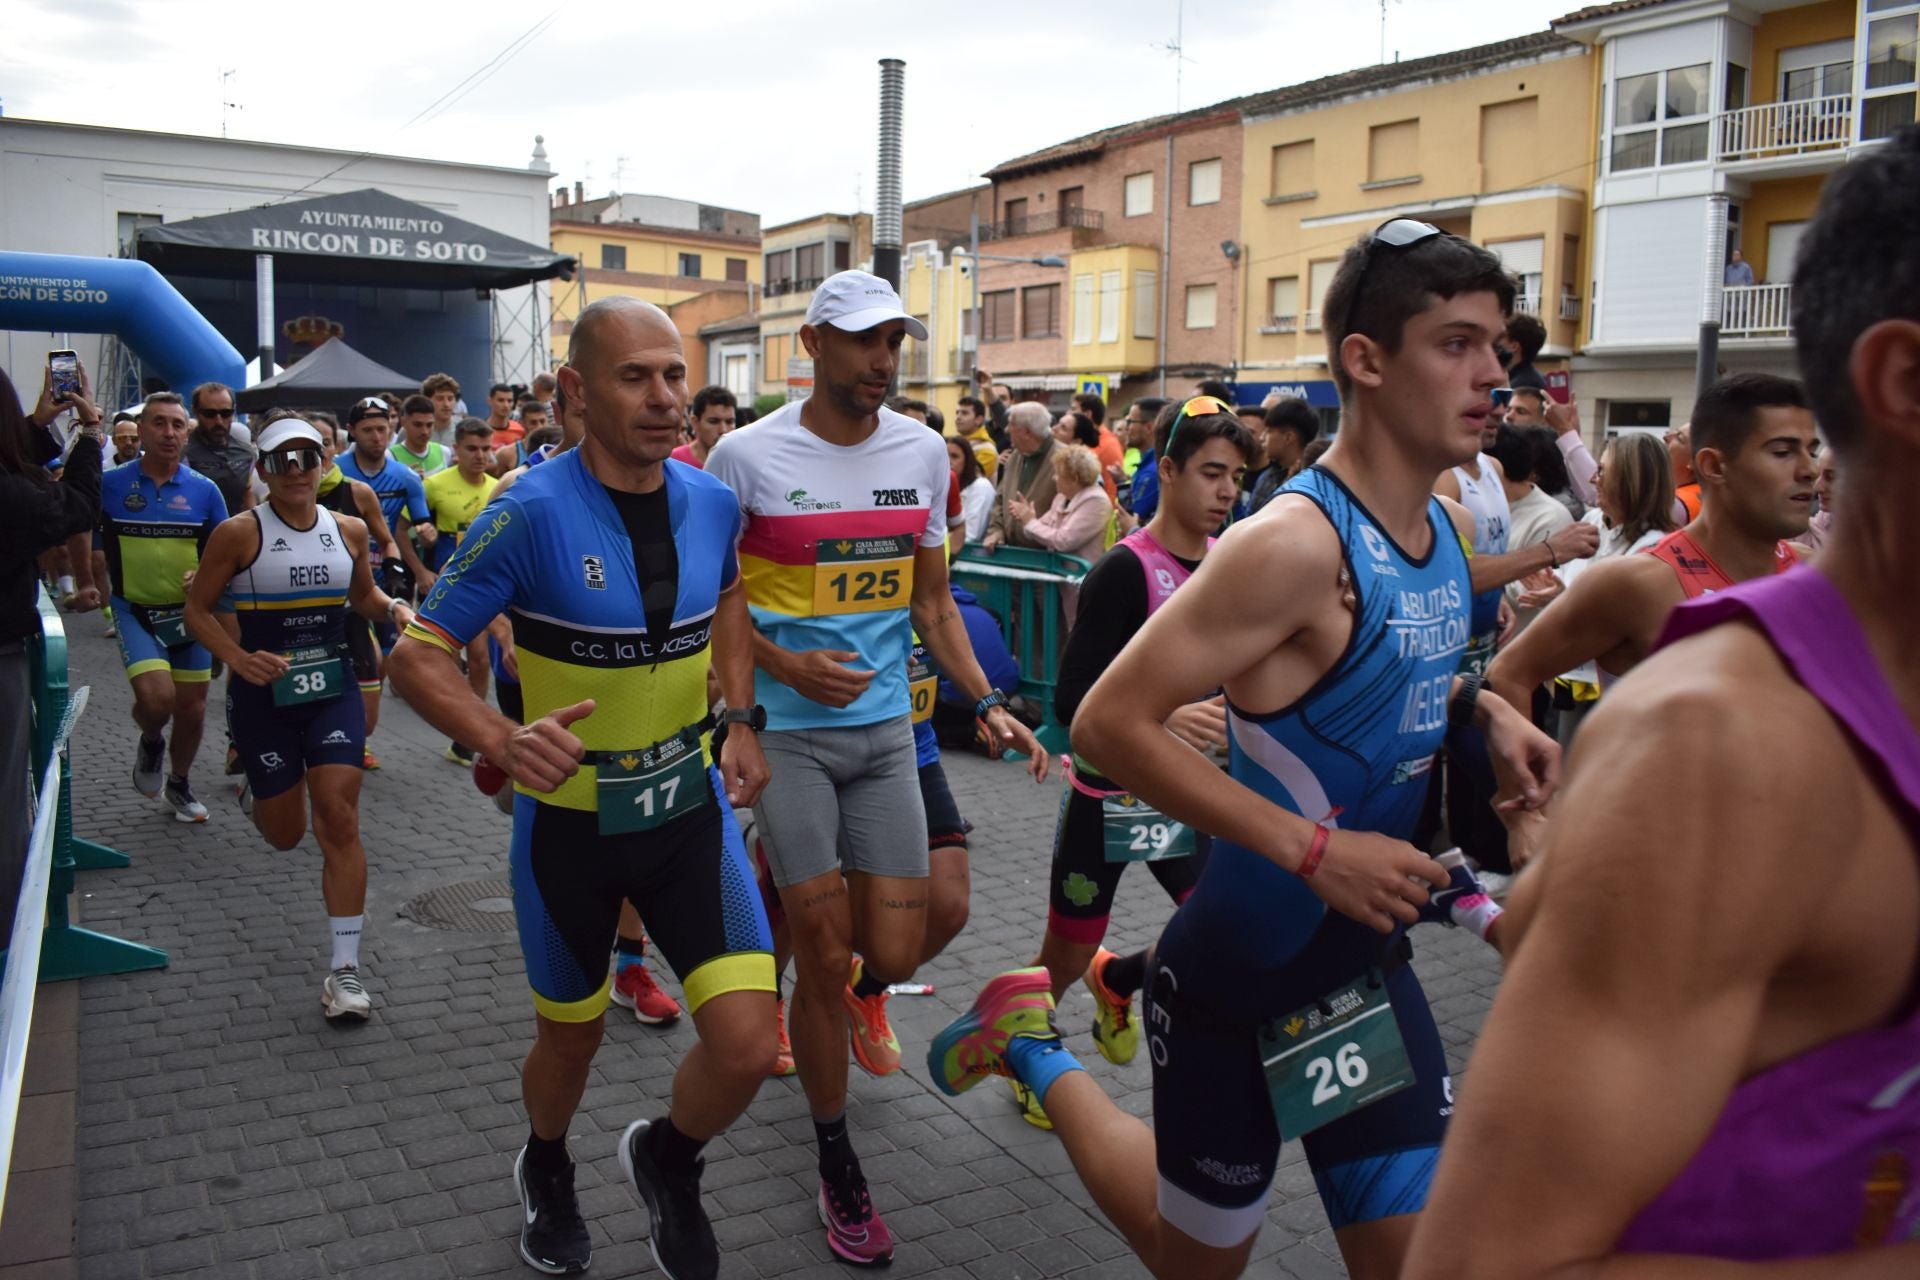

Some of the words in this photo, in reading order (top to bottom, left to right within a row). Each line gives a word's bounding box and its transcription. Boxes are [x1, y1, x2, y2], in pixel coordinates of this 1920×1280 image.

[300, 210, 444, 234] AYUNTAMIENTO
[252, 228, 358, 254] RINCON
[370, 236, 405, 257] DE
[416, 241, 487, 262] SOTO
[73, 279, 88, 289] DE
[36, 288, 58, 301] DE
[63, 289, 108, 304] SOTO
[873, 488, 919, 507] 226ERS
[874, 539, 896, 547] RURAL
[290, 565, 329, 587] REYES
[830, 568, 899, 602] 125
[1400, 579, 1461, 619] ABLITAS
[615, 642, 636, 660] la
[293, 671, 326, 694] 38
[634, 776, 680, 817] 17
[1129, 823, 1169, 850] 29
[1305, 1042, 1368, 1106] 26
